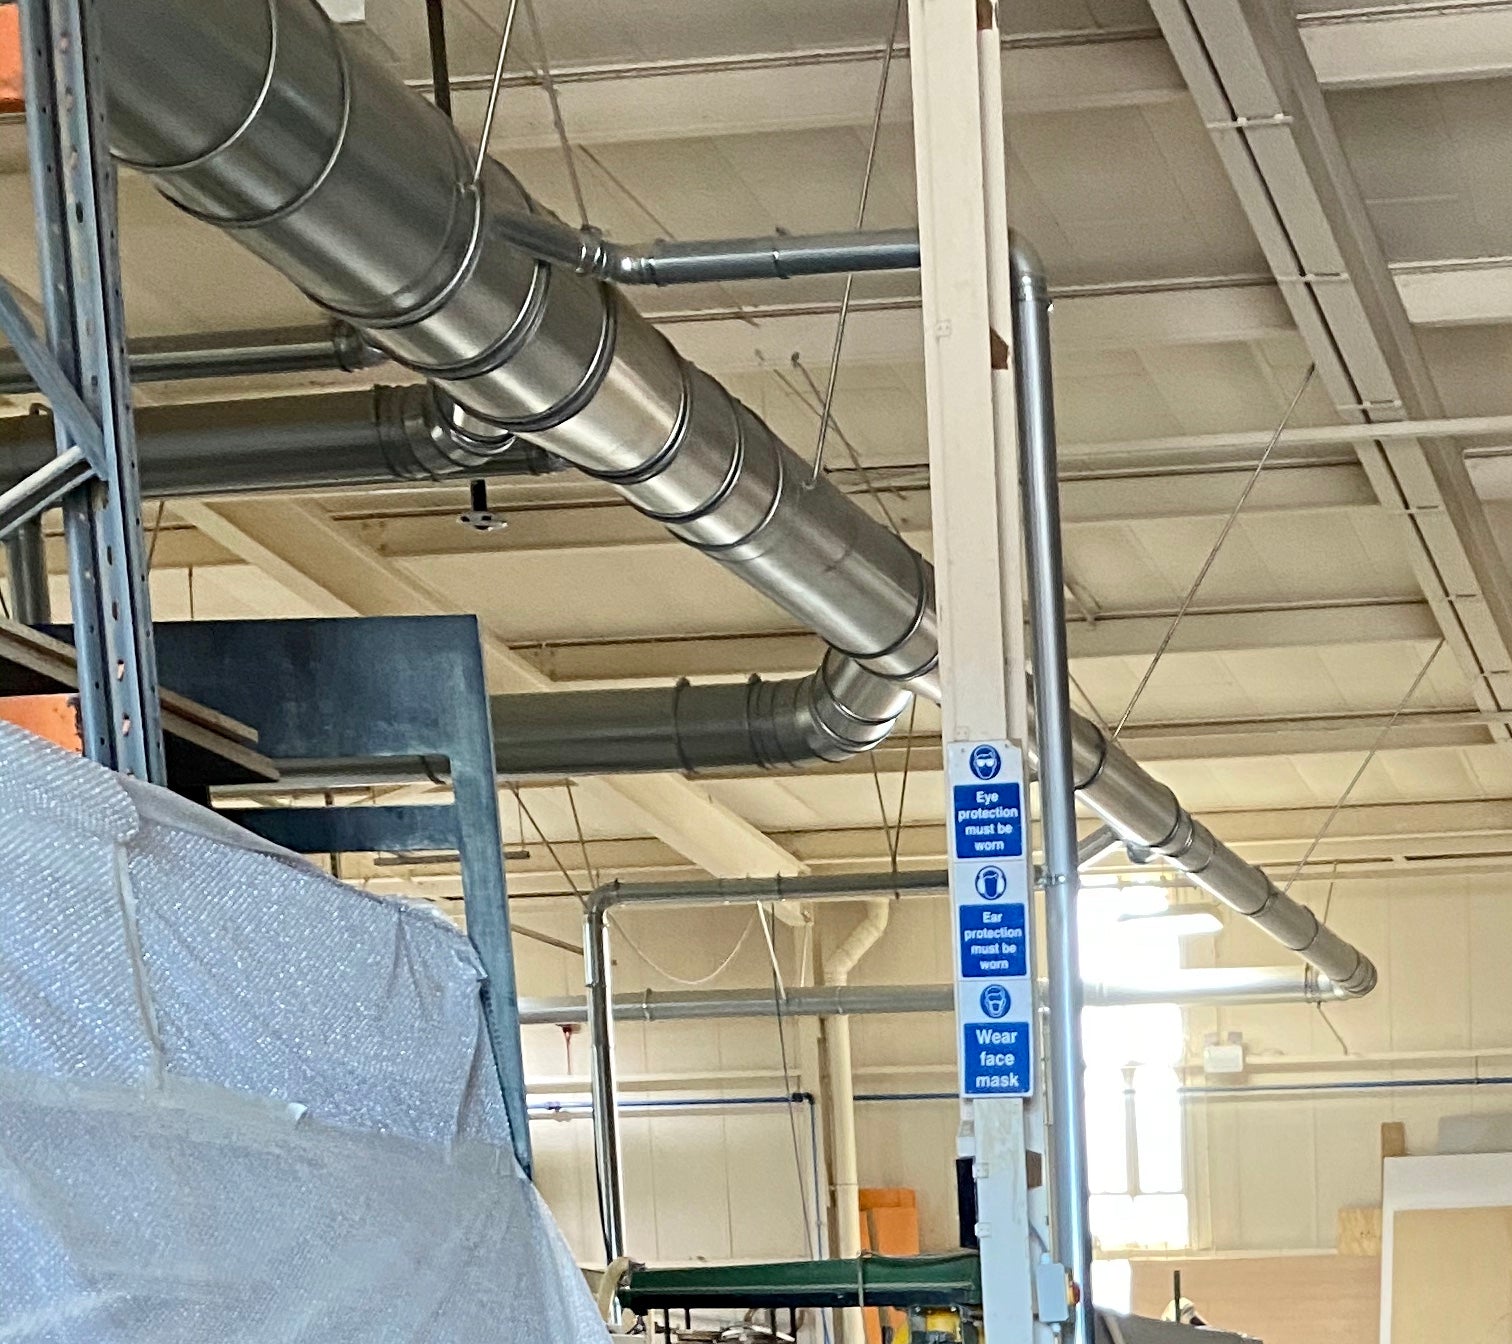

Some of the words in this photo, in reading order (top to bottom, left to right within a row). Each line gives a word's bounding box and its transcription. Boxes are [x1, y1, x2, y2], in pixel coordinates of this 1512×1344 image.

[976, 790, 999, 805] Eye
[957, 806, 1019, 823] protection
[965, 823, 995, 836] must
[997, 822, 1013, 834] be
[974, 840, 1005, 851] worn
[982, 911, 1003, 923] Ear
[964, 926, 1023, 942] protection
[970, 942, 1000, 955] must
[1001, 942, 1017, 954] be
[979, 959, 1010, 970] worn
[975, 1028, 1018, 1045] Wear
[979, 1050, 1016, 1067] face
[975, 1072, 1020, 1088] mask
